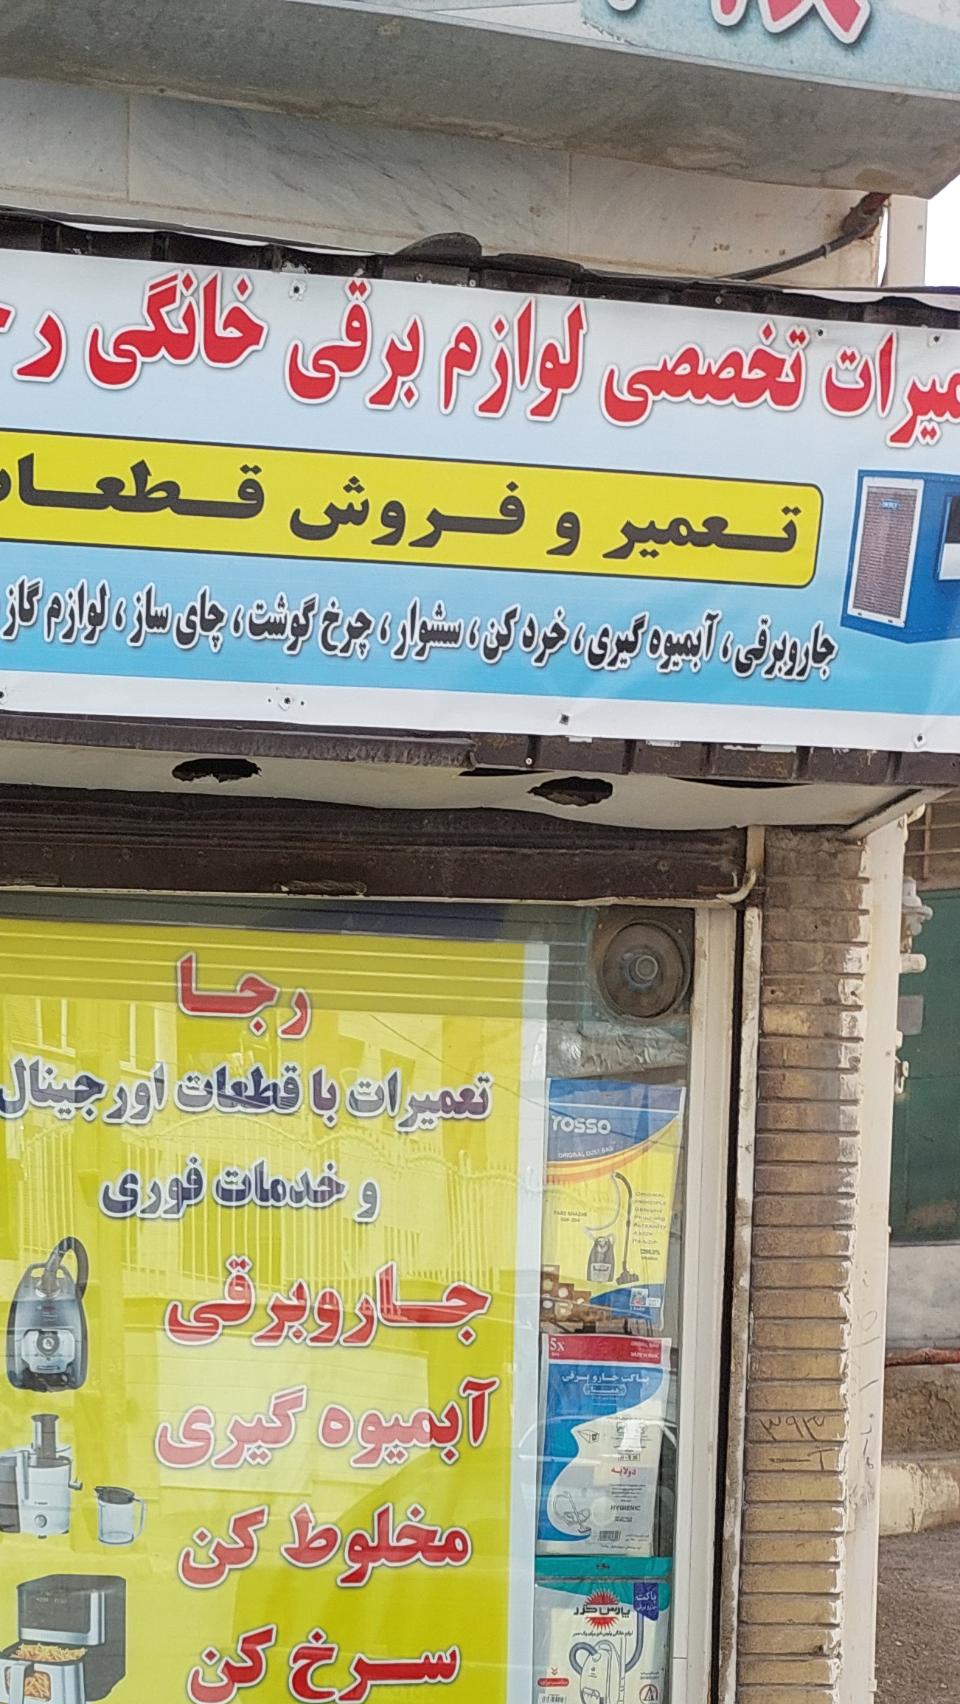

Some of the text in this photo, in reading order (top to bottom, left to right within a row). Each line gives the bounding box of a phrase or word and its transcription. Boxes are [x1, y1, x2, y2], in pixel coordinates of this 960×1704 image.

[87, 270, 266, 389] خانگی
[287, 281, 422, 412] برقی
[442, 299, 588, 419] لوازم
[604, 320, 806, 425] تخصصی
[289, 475, 525, 549] فروش
[546, 511, 581, 557] و
[602, 502, 800, 560] تعمیر
[0, 574, 43, 640] گاز
[44, 578, 109, 645] لوازم
[173, 583, 228, 651] چای
[320, 596, 375, 660] چرخ
[522, 606, 567, 667] خرد
[648, 608, 720, 673] آبمیوه
[177, 952, 313, 1038] رجا
[176, 1063, 301, 1115] قطعات
[309, 1073, 338, 1126] با
[347, 1069, 493, 1132] تعمیرات
[99, 1153, 380, 1222] و خدمات فوری
[166, 1255, 493, 1346] جاروبرقی
[155, 1377, 501, 1470] آبمیوه گیری
[178, 1503, 472, 1588] مخلوط کن
